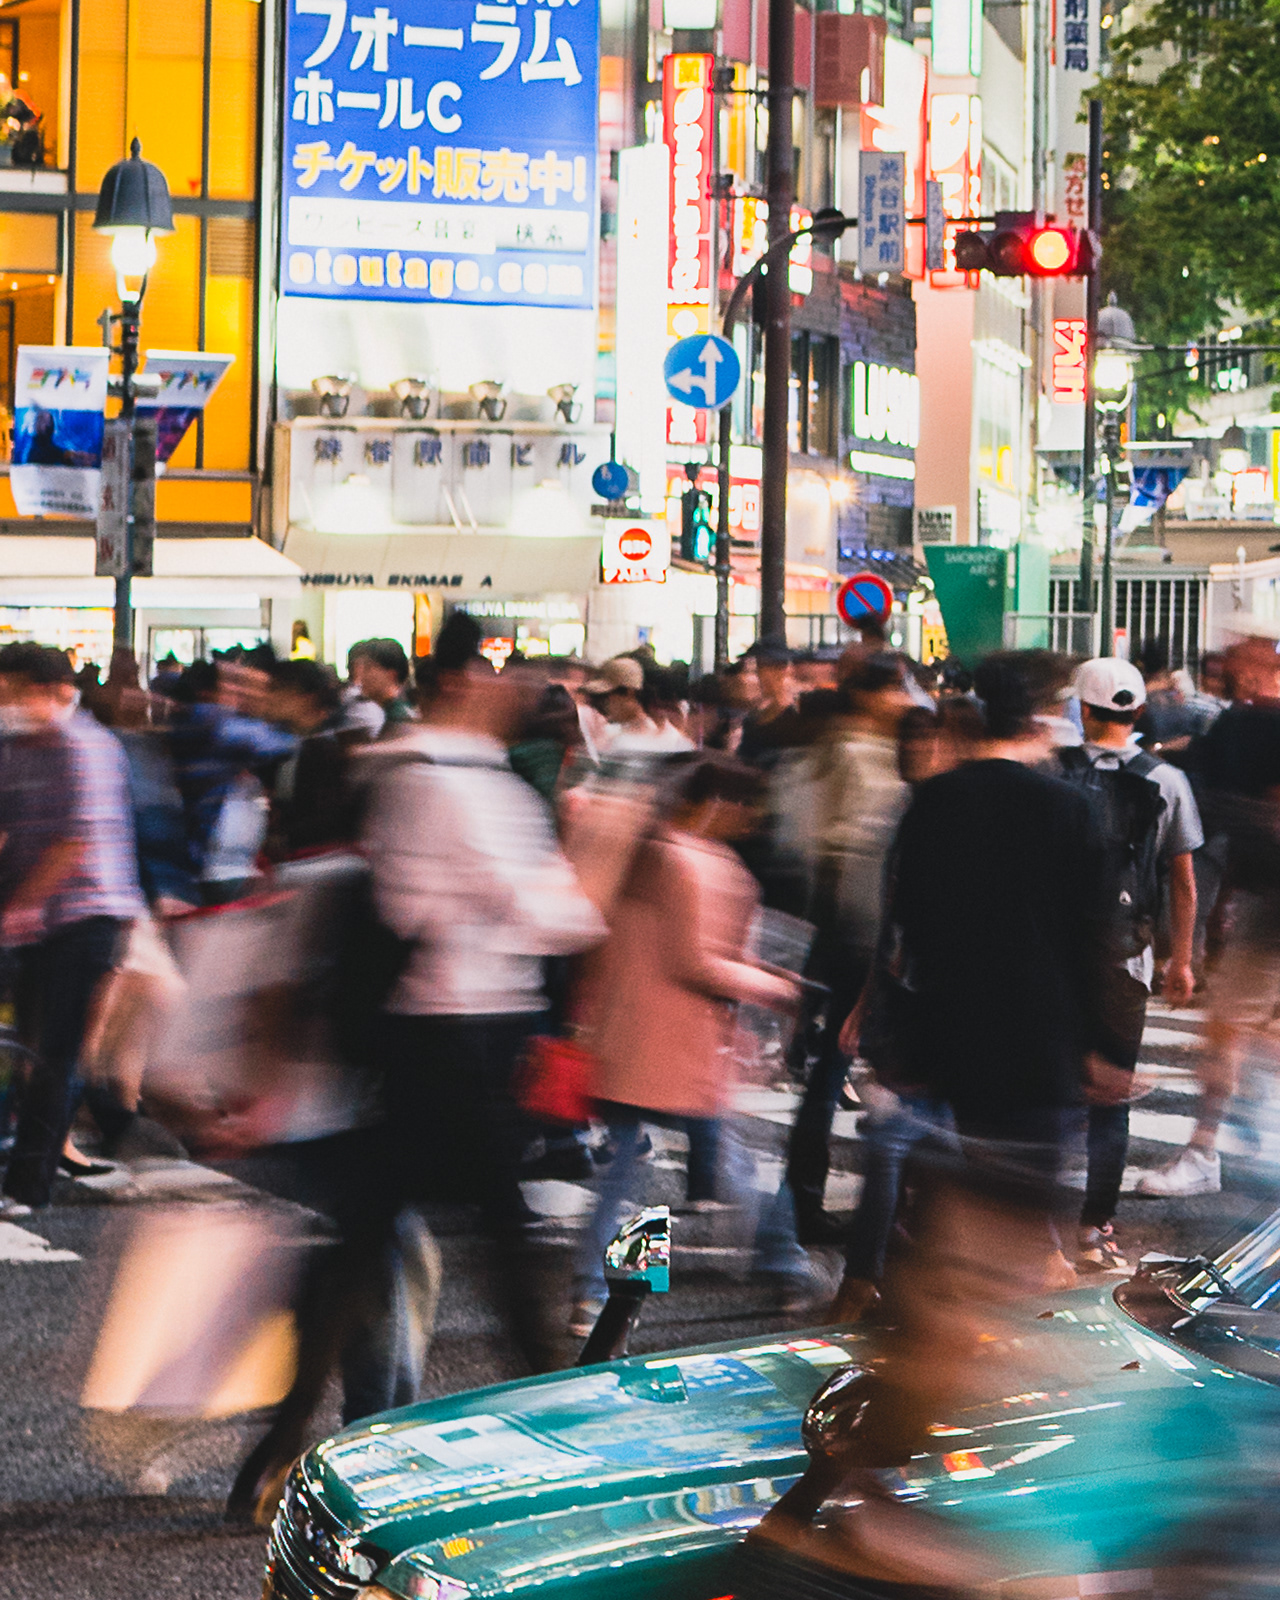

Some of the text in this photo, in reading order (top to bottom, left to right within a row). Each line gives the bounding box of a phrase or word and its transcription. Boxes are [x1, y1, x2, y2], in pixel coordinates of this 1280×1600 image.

[292, 71, 463, 134] ホールC
[293, 140, 588, 206] チケット販売中!
